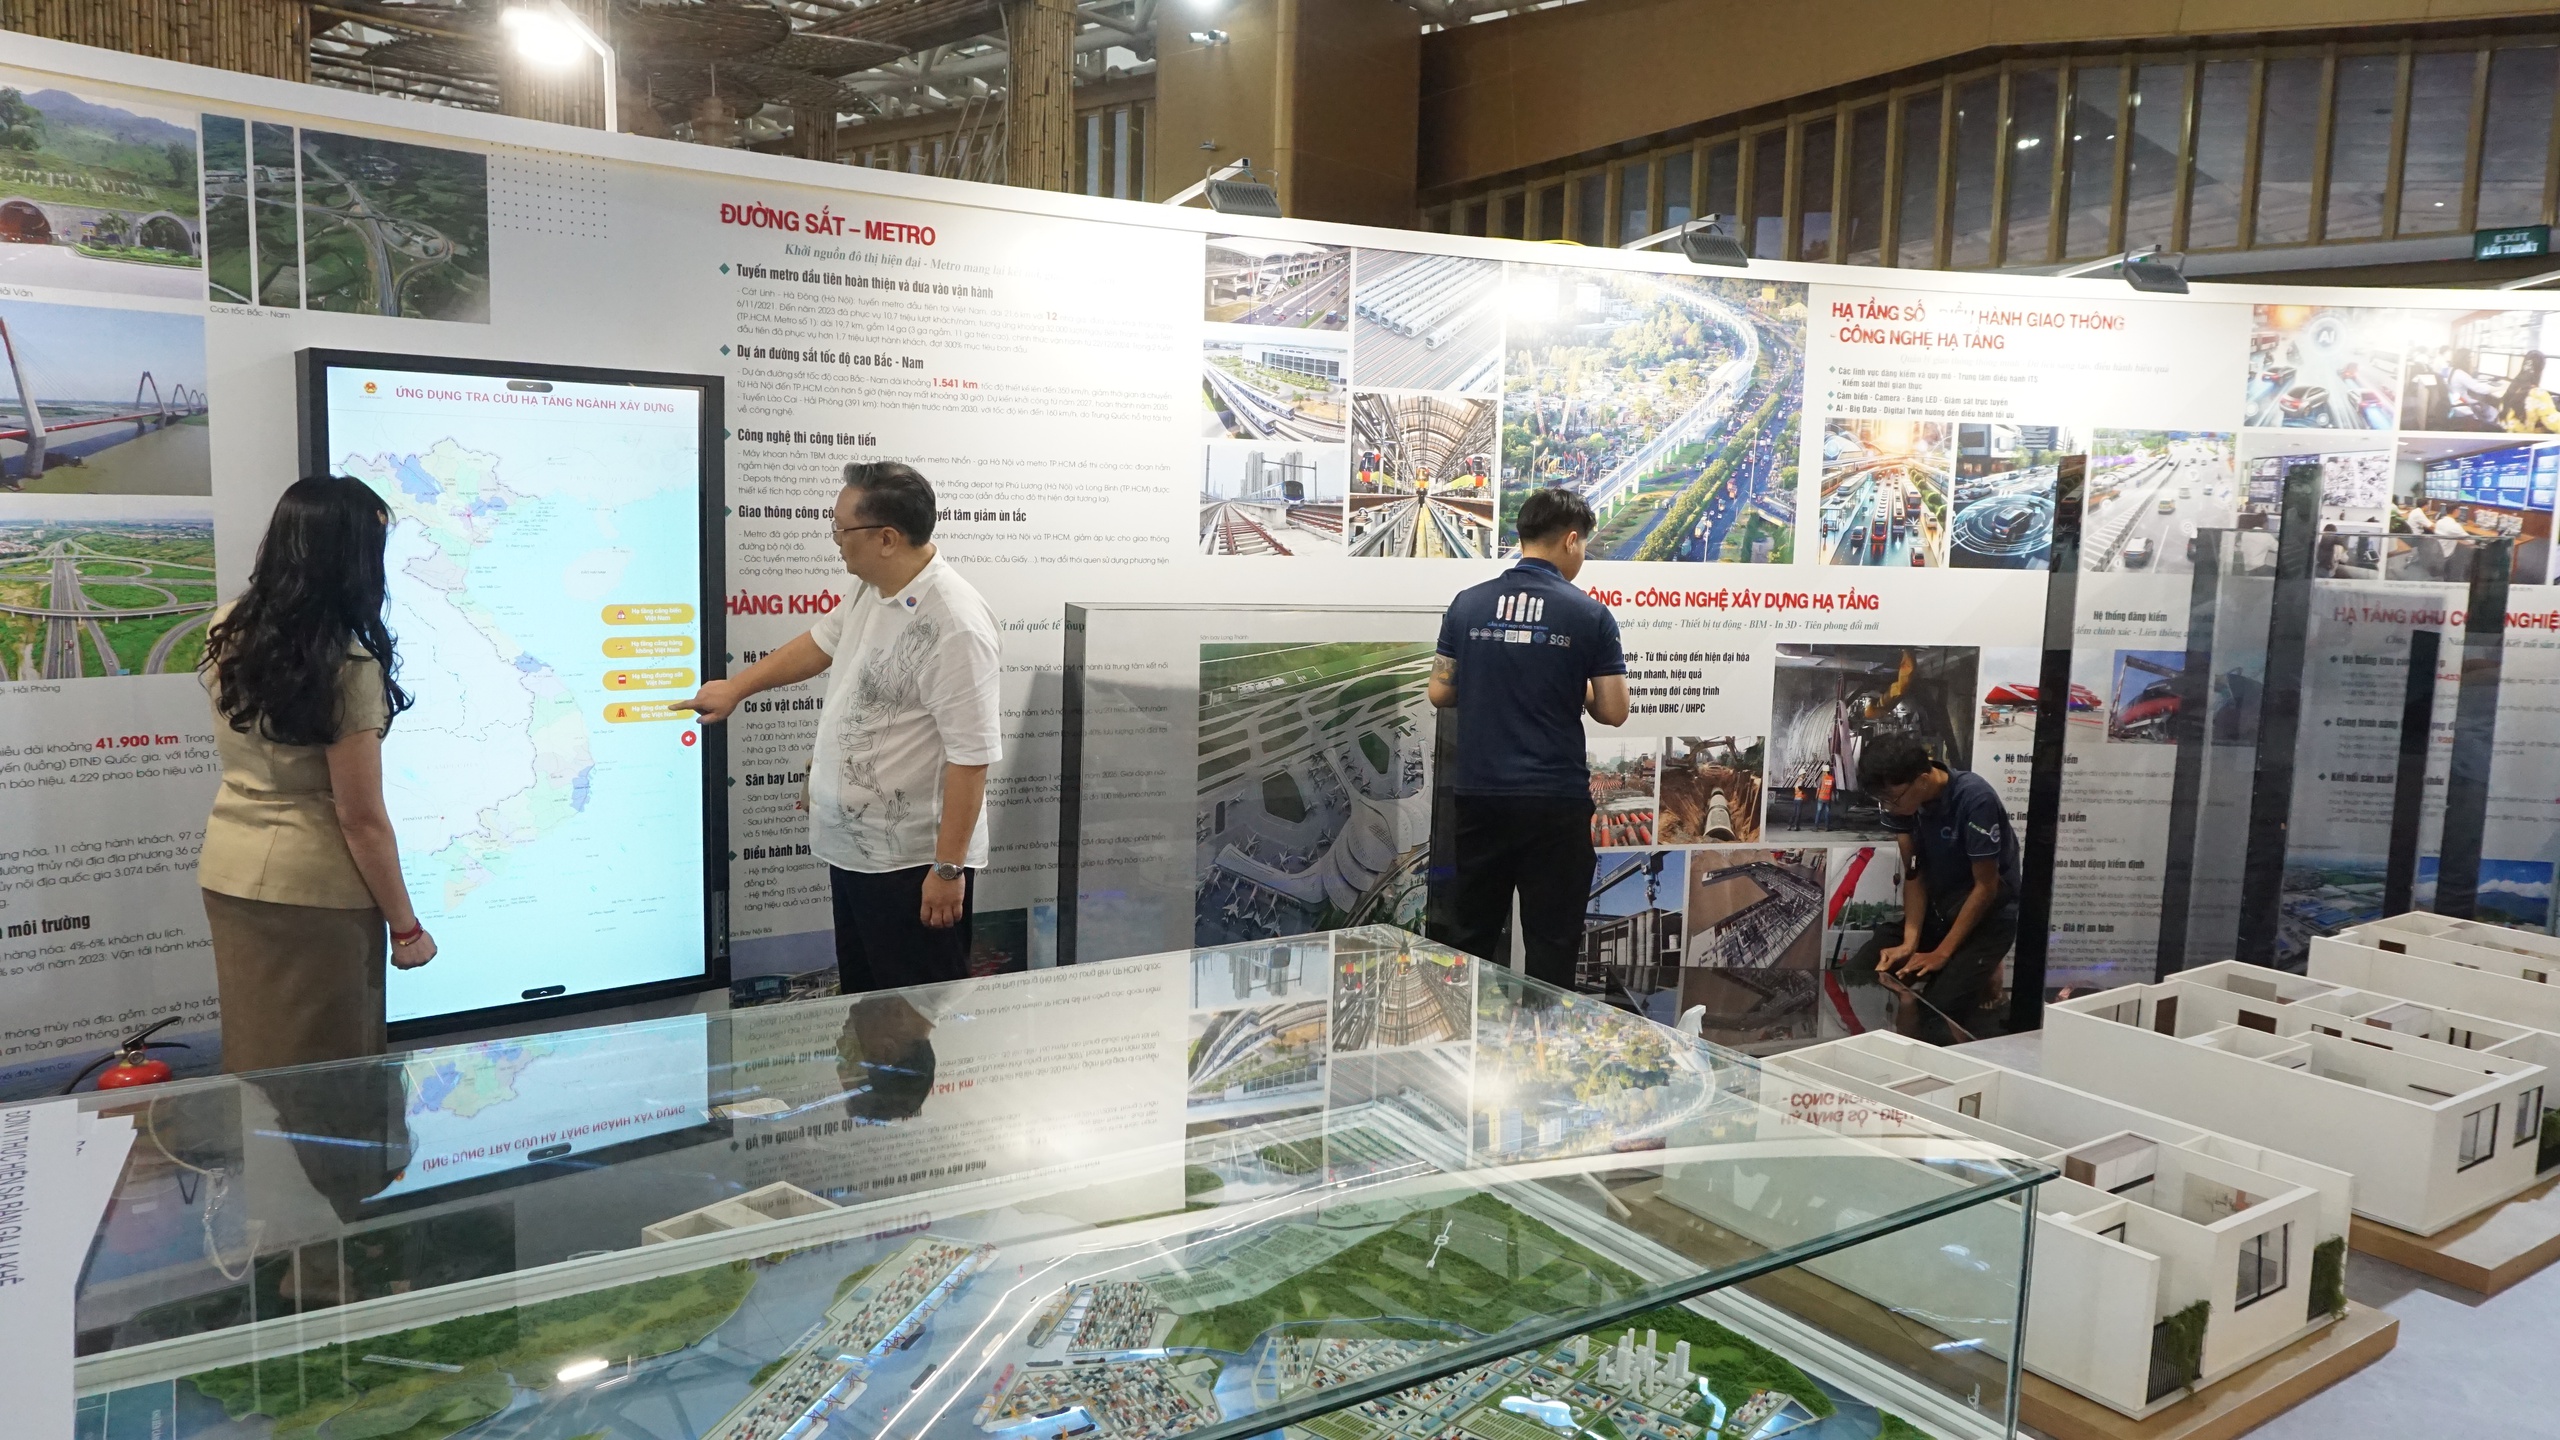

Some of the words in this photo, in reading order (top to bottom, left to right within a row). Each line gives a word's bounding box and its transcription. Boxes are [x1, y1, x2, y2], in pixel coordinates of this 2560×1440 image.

[720, 201, 800, 231] ĐƯỜNG
[805, 206, 846, 235] SẮT
[865, 221, 937, 246] METRO
[2494, 232, 2530, 244] EXIT
[785, 244, 811, 257] Khởi
[813, 247, 846, 260] nguồn
[848, 250, 862, 262] đô
[864, 252, 879, 266] thị
[880, 254, 903, 268] hiện
[904, 256, 922, 269] đại
[931, 258, 961, 271] Metro
[963, 264, 990, 275] mang
[736, 263, 767, 279] Tuyến
[769, 269, 799, 282] metro
[802, 269, 821, 284] đầu
[822, 272, 842, 286] tiên
[844, 274, 869, 288] hoàn
[871, 277, 896, 292] thiện
[898, 280, 910, 292] và
[912, 280, 930, 294] đưa
[932, 282, 949, 295] vào
[951, 284, 968, 299] vận
[970, 286, 994, 299] hành
[209, 305, 230, 314] Cao
[230, 307, 245, 316] tốc
[246, 308, 263, 317] Bắc
[270, 310, 291, 319] Nam
[1832, 302, 1854, 322] HẠ
[1857, 296, 1899, 322] TẦNG
[1977, 305, 2023, 326] HÀNH
[2026, 313, 2065, 329] GIAO
[2069, 310, 2125, 331] THÔNG
[1839, 323, 1885, 345] CÔNG
[1889, 328, 1934, 351] NGHỆ
[1937, 331, 1959, 352] HẠ
[1962, 325, 2005, 350] TẦNG
[2318, 329, 2336, 344] AI
[737, 344, 751, 360] Dự
[753, 345, 766, 359] án
[768, 347, 800, 362] đường
[802, 347, 818, 362] sắt
[820, 349, 836, 364] tốc
[838, 352, 851, 367] độ
[853, 355, 872, 366] cao
[874, 352, 893, 367] Bắc
[902, 356, 924, 369] Nam
[933, 378, 959, 388] 1.541
[962, 380, 979, 389] km
[394, 387, 424, 399] ỨNG
[426, 389, 462, 400] DỤNG
[465, 390, 490, 402] TRA
[492, 393, 519, 404] CỨU
[520, 395, 539, 405] HẠ
[542, 395, 573, 407] TẦNG
[574, 398, 617, 409] NGÀNH
[620, 401, 640, 410] XÂY
[643, 402, 676, 413] DỰNG
[1836, 404, 1843, 412] AI
[1849, 404, 1861, 414] Big
[1862, 405, 1878, 414] Data
[1883, 406, 1906, 415] Digital
[1907, 407, 1923, 415] Twin
[737, 428, 764, 443] Công
[766, 430, 791, 445] nghệ
[793, 431, 807, 444] thi
[809, 432, 834, 446] công
[836, 433, 855, 445] tiên
[857, 432, 876, 446] tiến
[738, 505, 762, 518] Giao
[764, 505, 792, 520] thông
[795, 506, 820, 520] công
[822, 506, 834, 522] cộ
[937, 507, 952, 522] yết
[953, 509, 972, 521] tâm
[974, 508, 997, 522] giảm
[999, 510, 1010, 522] ùn
[1012, 508, 1027, 522] tắc
[725, 589, 783, 616] HÀNG
[788, 589, 846, 615] KHÔ
[1634, 586, 1681, 607] CÔNG
[1684, 588, 1728, 612] NGHỆ
[1731, 588, 1762, 608] XÂY
[1764, 592, 1809, 612] DỰNG
[1812, 594, 1835, 613] HẠ
[1838, 587, 1880, 610] TẦNG
[2093, 610, 2104, 621] Hệ
[2104, 610, 2126, 622] thống
[2127, 611, 2147, 622] đăng
[2148, 611, 2168, 622] kiểm
[2505, 608, 2560, 632] NGHIỆ
[1009, 618, 1025, 631] nối
[1026, 618, 1050, 633] quốc
[1052, 618, 1063, 630] tế
[1637, 618, 1650, 630] xây
[1652, 619, 1673, 630] dựng
[1680, 618, 1701, 628] Thiết
[1702, 619, 1711, 630] bị
[1712, 621, 1722, 630] tự
[1722, 619, 1742, 630] động
[1749, 620, 1768, 629] BIM
[1774, 620, 1784, 629] In
[1784, 620, 1798, 629] 3D
[1805, 620, 1822, 629] Tiên
[1822, 621, 1848, 632] phong
[1849, 619, 1863, 630] đổi
[1864, 622, 1880, 630] mới
[1549, 633, 1571, 647] SGS
[1645, 651, 1654, 662] Từ
[1656, 651, 1668, 662] thủ
[1669, 652, 1688, 663] công
[1689, 650, 1703, 662] đến
[1704, 652, 1721, 664] hiện
[1722, 652, 1735, 663] đại
[1736, 652, 1750, 662] hóa
[1643, 669, 1669, 679] nhanh,
[1670, 669, 1687, 680] hiệu
[1688, 668, 1702, 680] quả
[1649, 687, 1668, 697] vòng
[1669, 686, 1681, 696] đời
[1682, 686, 1701, 697] công
[1702, 686, 1720, 696] trình
[743, 696, 758, 713] Cơ
[760, 698, 772, 712] sở
[774, 699, 790, 714] vật
[792, 696, 814, 711] chất
[1640, 703, 1658, 715] kiện
[1658, 703, 1679, 713] UBHC
[1685, 703, 1706, 713] UHPC
[23, 745, 44, 755] dài
[46, 742, 92, 753] khoảng
[95, 736, 150, 749] 41.900
[184, 734, 215, 744] Trong
[745, 774, 765, 786] Sân
[767, 773, 785, 786] bay
[743, 846, 766, 860] Điều
[768, 844, 793, 858] hành
[795, 844, 812, 856] bay
[7, 920, 38, 938] môi
[41, 915, 91, 933] trường
